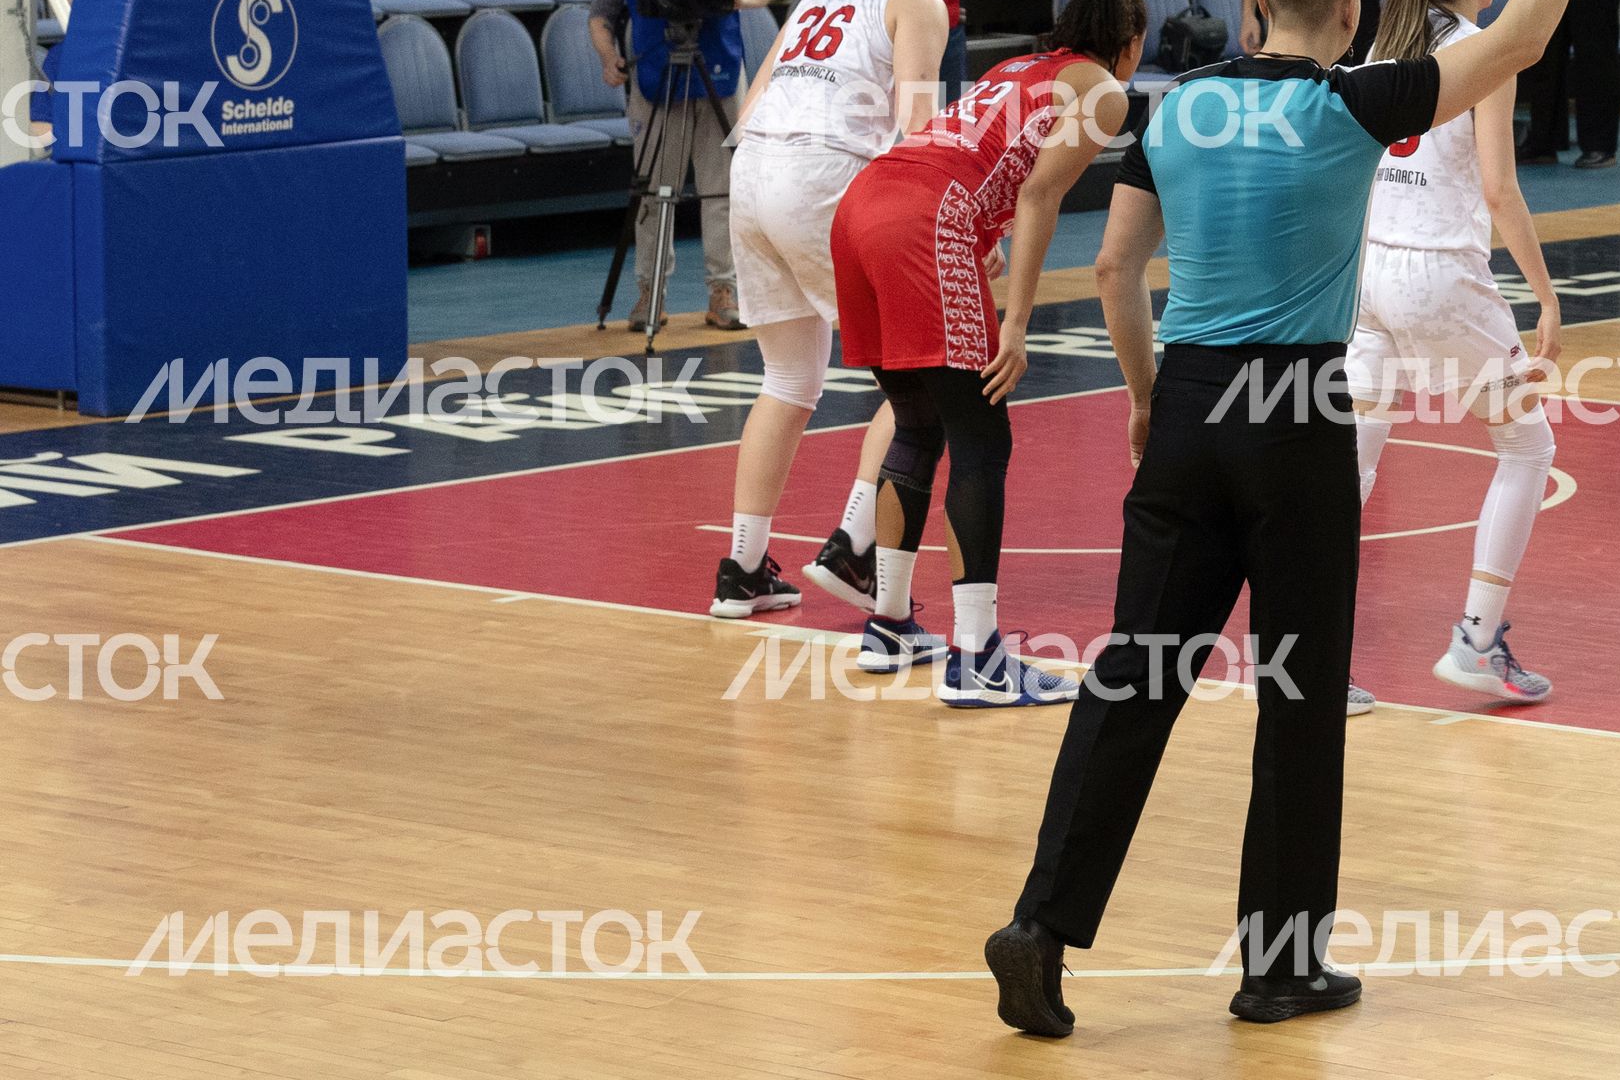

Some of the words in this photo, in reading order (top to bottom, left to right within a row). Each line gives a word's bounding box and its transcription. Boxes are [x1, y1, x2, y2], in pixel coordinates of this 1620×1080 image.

[779, 4, 856, 63] 36
[221, 95, 294, 120] Schelde
[221, 117, 293, 136] International
